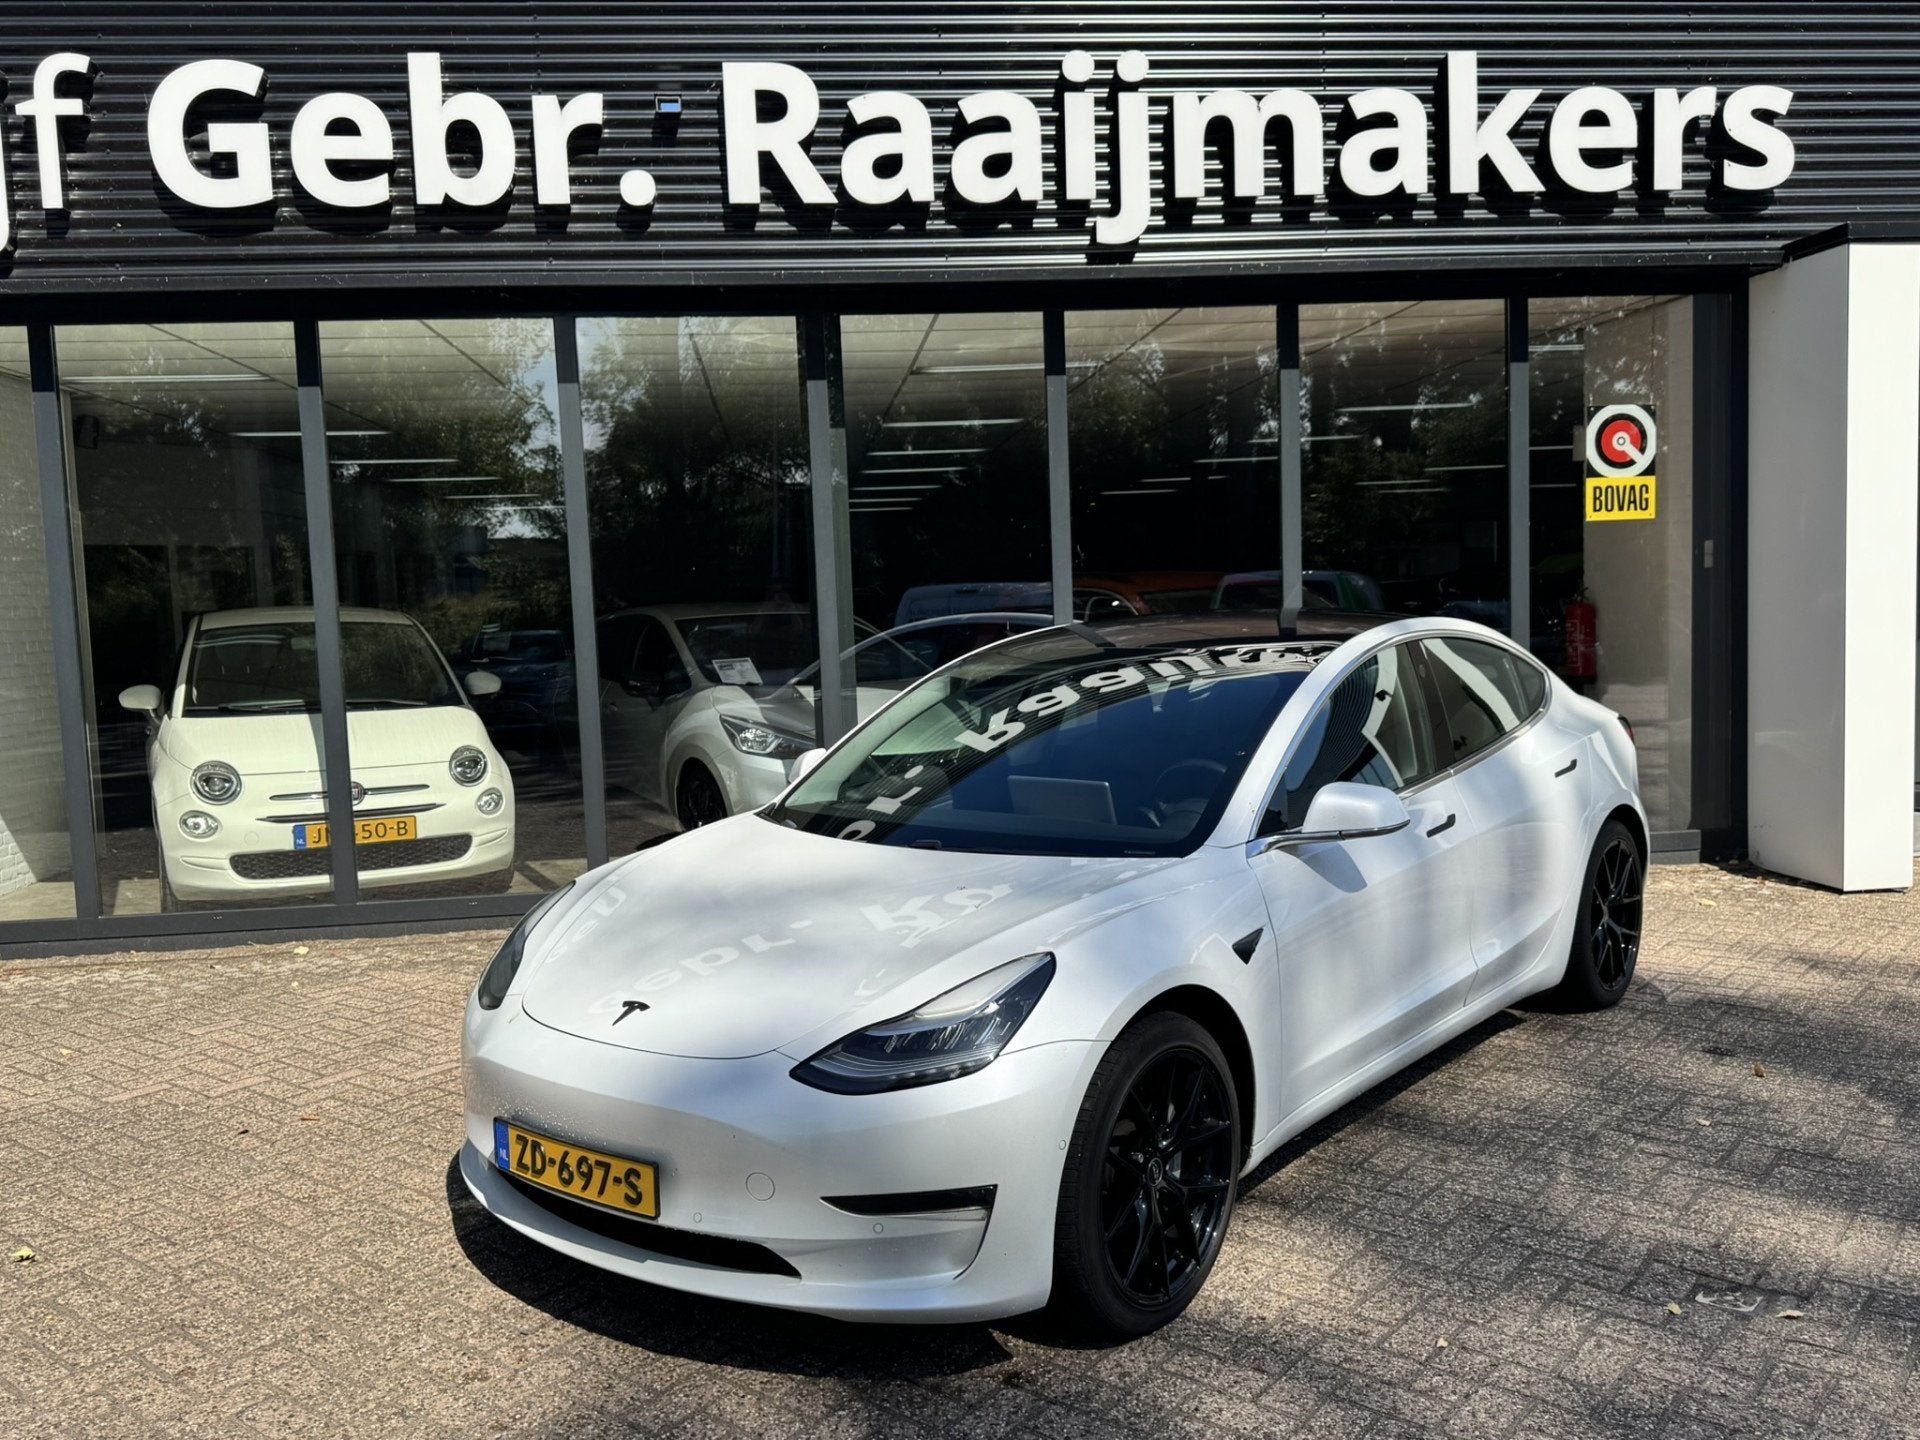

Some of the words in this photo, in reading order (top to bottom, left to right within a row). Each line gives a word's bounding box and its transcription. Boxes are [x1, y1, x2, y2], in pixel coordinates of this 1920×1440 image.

[147, 52, 656, 208] Gebr.
[722, 50, 1796, 244] Raaijmakers
[1592, 483, 1650, 512] BOVAG
[515, 1133, 643, 1208] ZD-697-S
